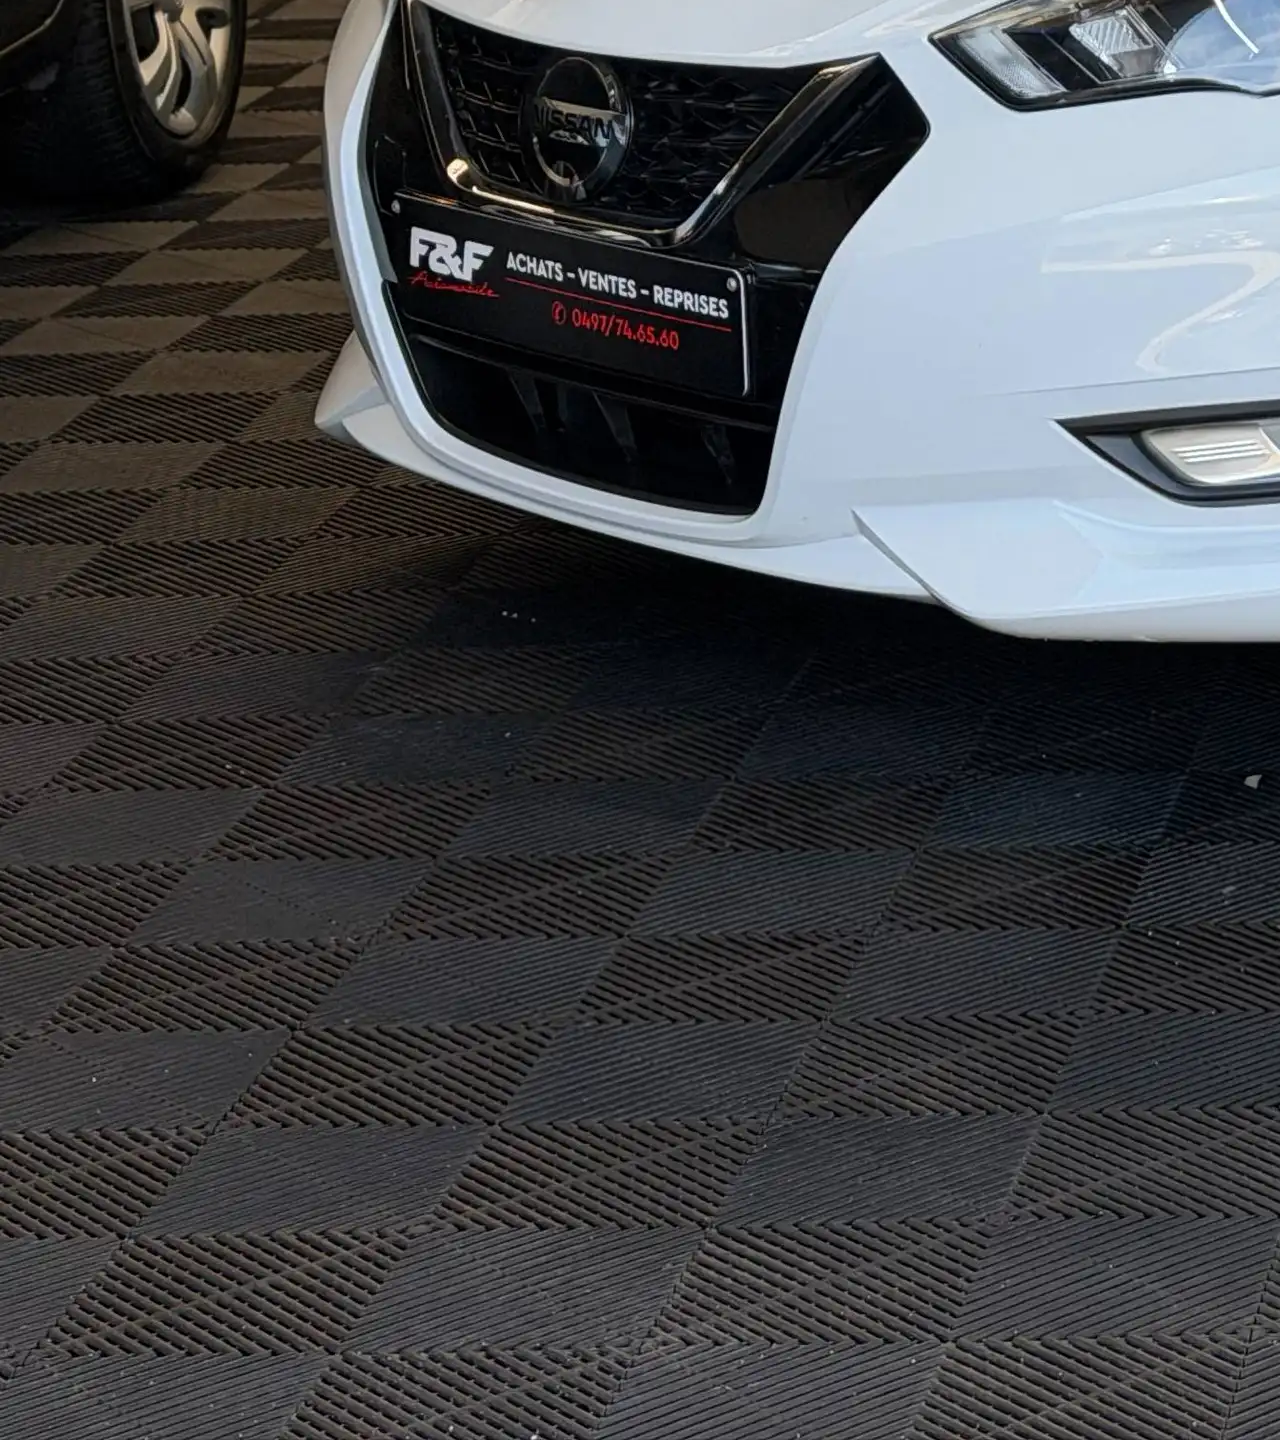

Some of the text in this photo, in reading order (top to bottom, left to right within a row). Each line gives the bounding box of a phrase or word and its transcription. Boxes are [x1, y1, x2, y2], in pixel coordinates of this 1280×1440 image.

[409, 226, 495, 282] F&F
[506, 251, 564, 282] ACHATS
[577, 267, 637, 299] VENTES
[652, 284, 730, 319] REPRISES
[571, 308, 680, 350] 0497/74.65.60
